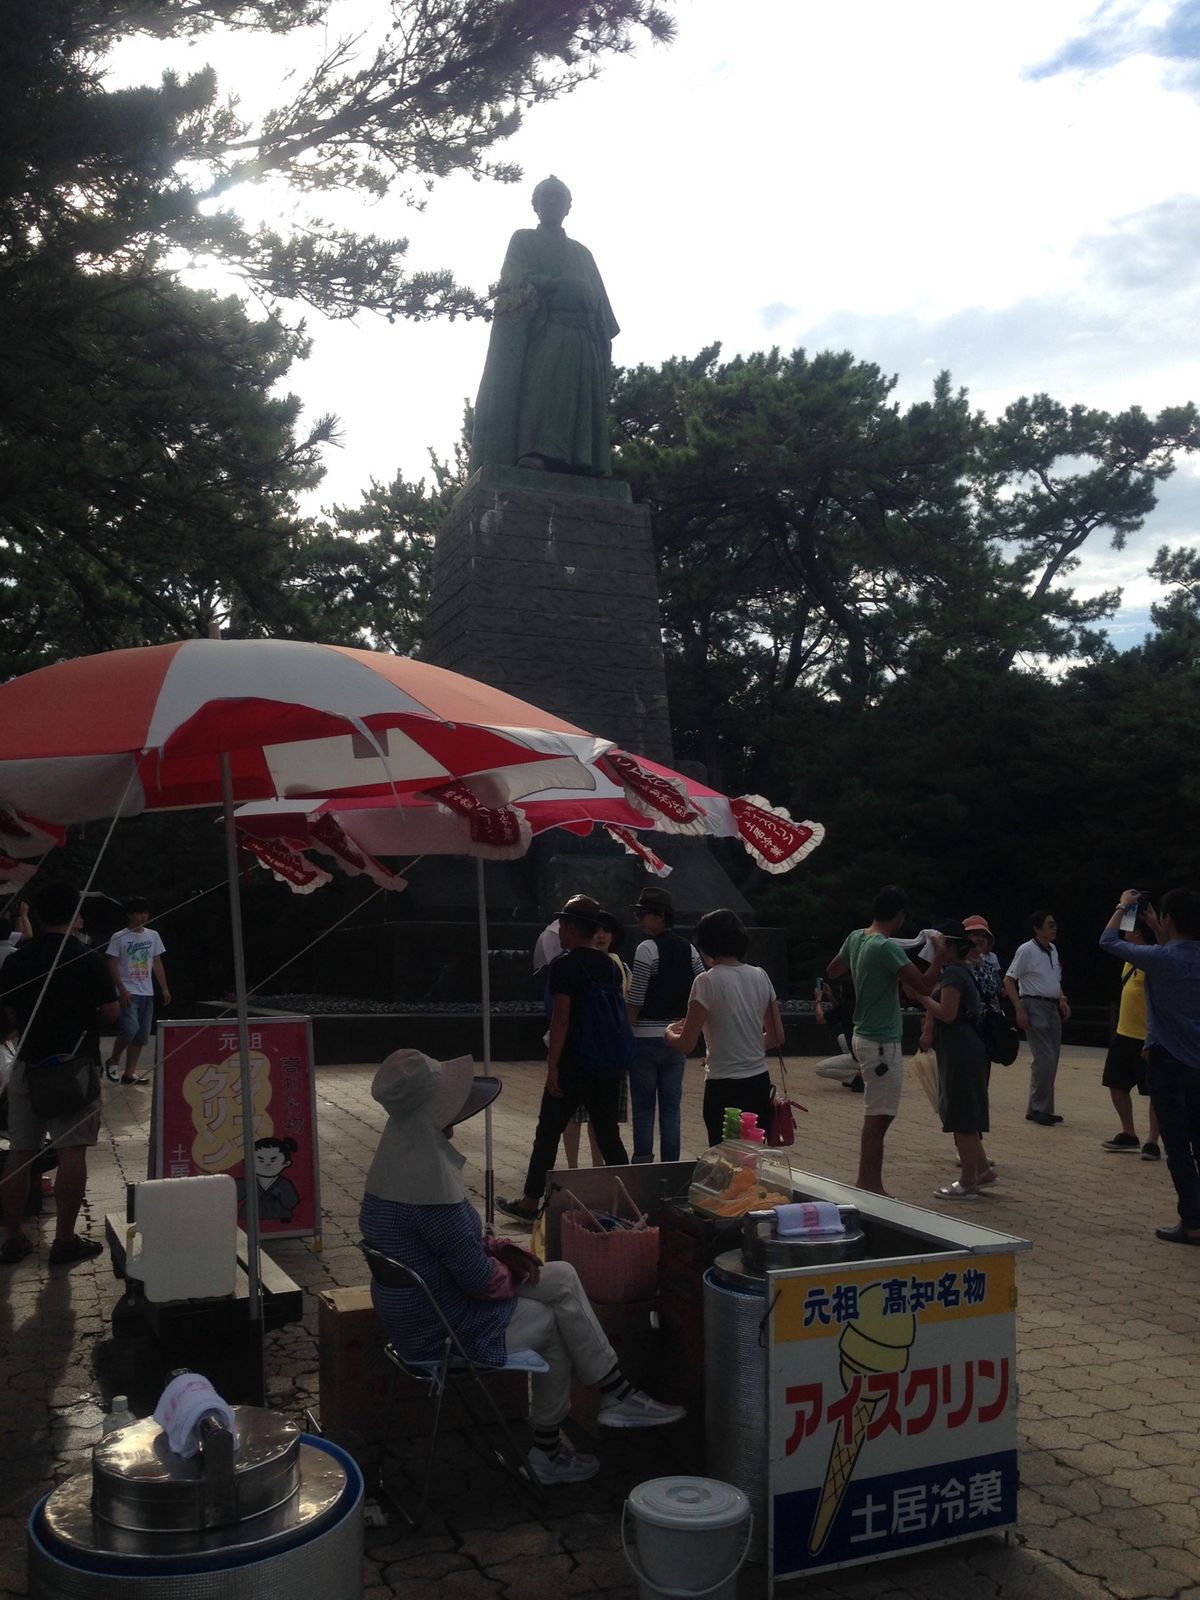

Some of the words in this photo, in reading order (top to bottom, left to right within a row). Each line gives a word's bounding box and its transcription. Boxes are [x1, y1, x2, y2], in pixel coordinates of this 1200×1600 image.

[804, 1286, 860, 1326] 元祖
[785, 1357, 1009, 1457] アイスクリン
[850, 1470, 1002, 1544] 土居冷菓
